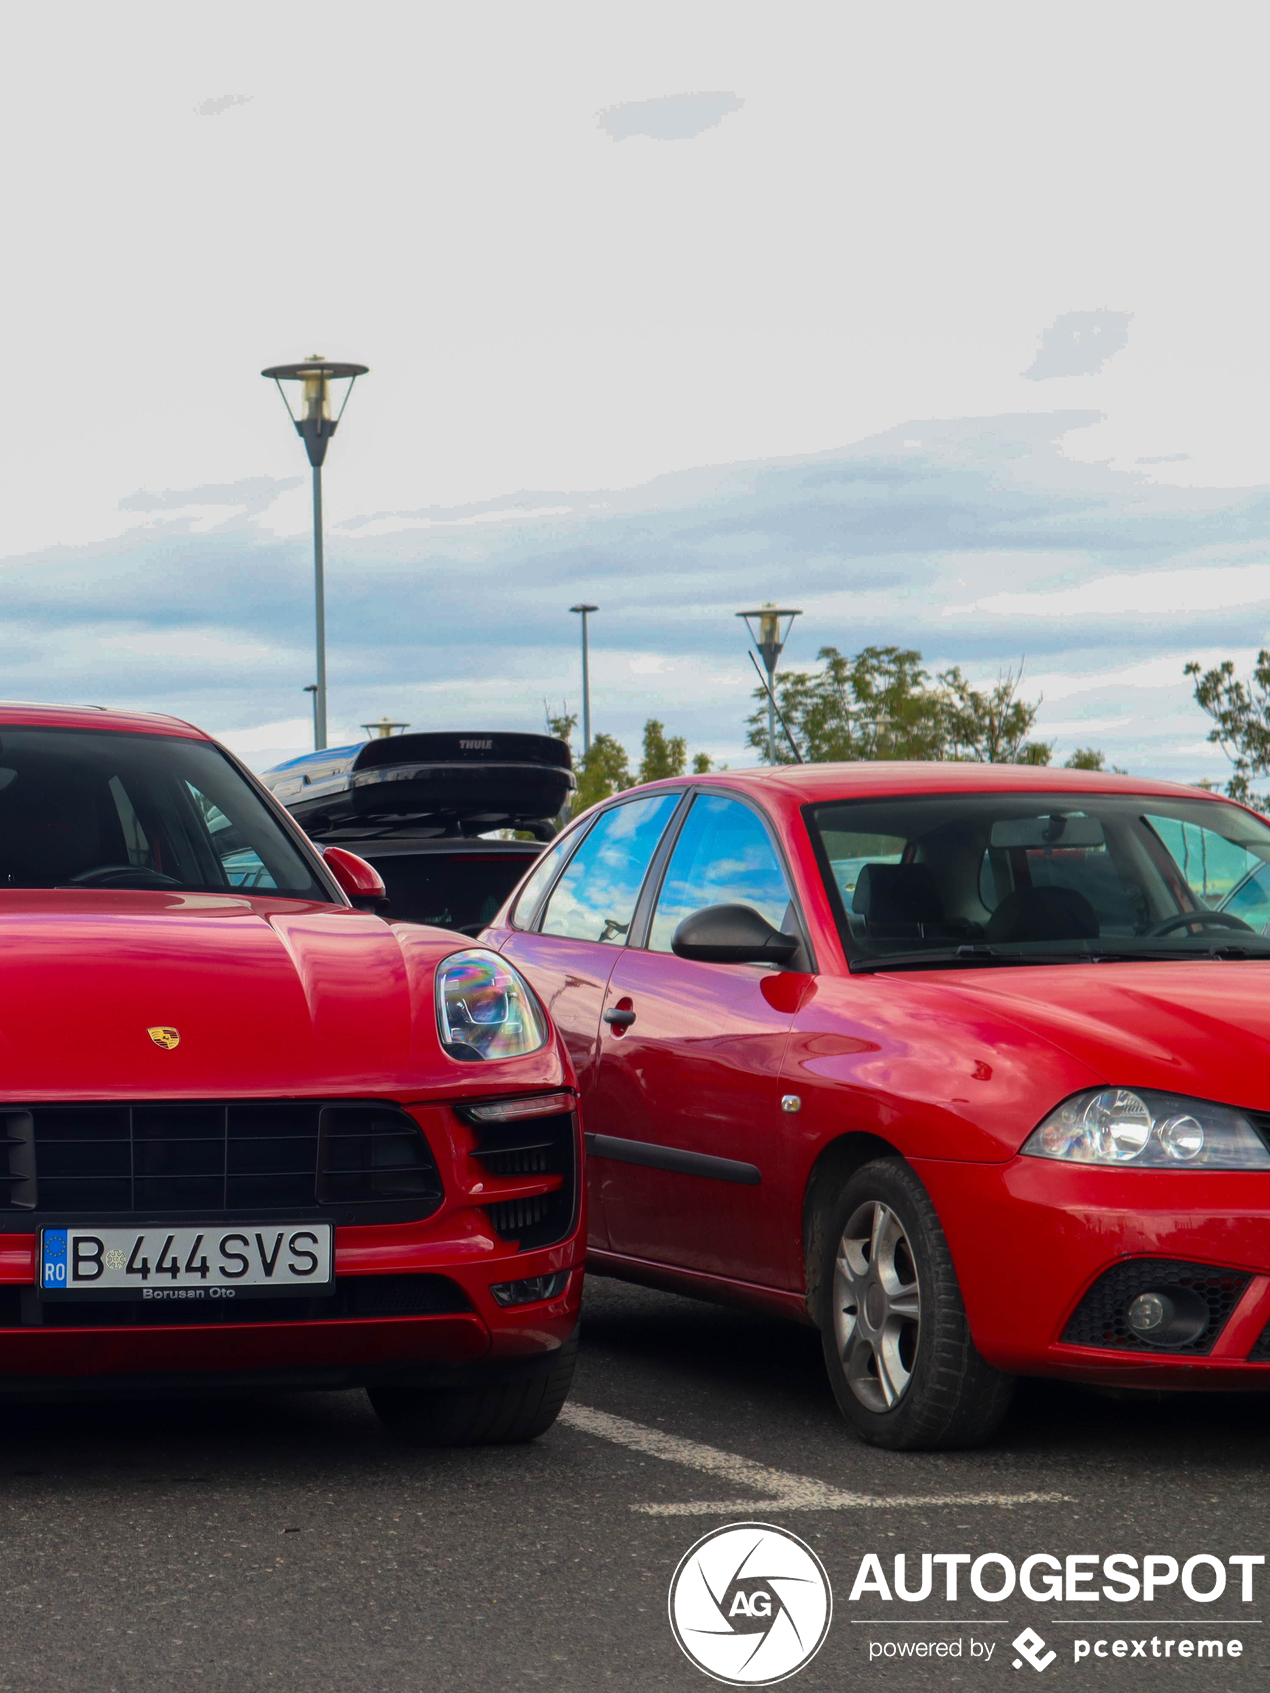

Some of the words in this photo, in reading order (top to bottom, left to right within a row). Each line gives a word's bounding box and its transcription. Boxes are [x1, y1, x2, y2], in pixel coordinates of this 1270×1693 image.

[459, 739, 493, 750] THULE
[45, 1263, 65, 1281] RO
[142, 1287, 205, 1300] Borusan
[209, 1286, 236, 1299] Oto
